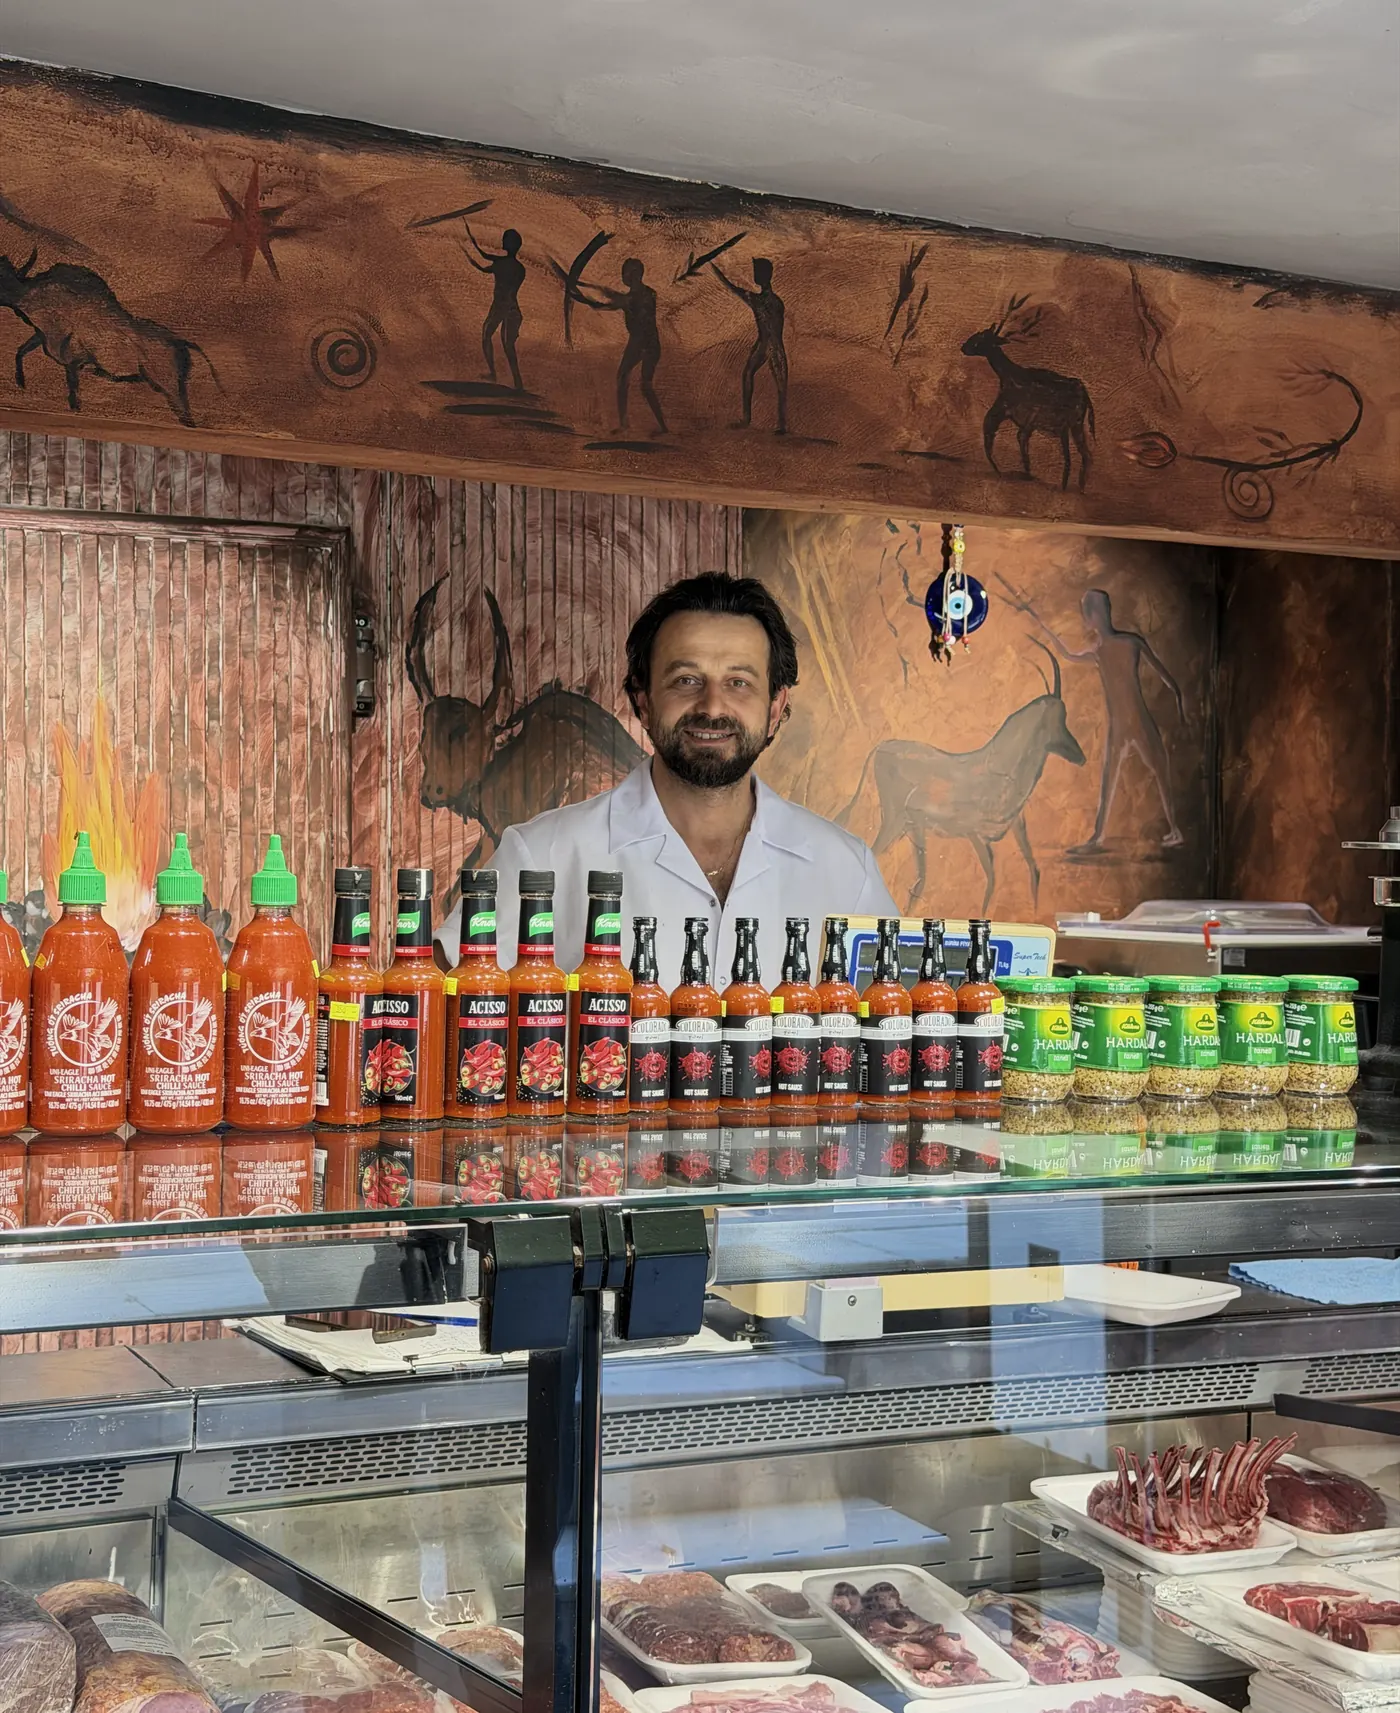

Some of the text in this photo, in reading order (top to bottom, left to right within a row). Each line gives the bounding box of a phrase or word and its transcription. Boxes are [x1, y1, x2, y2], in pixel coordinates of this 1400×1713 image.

[53, 991, 92, 1016] SRIRACHA
[149, 991, 187, 1015] SRIRACHA
[244, 991, 281, 1014] SRIRACHA
[468, 1000, 505, 1014] ACISSO
[527, 999, 563, 1012] ACISSO
[588, 998, 626, 1012] ACISSO
[1235, 1032, 1284, 1045] HARDAL
[8, 1075, 22, 1085] HOT
[54, 1074, 116, 1084] SRIRACHA HOT
[150, 1072, 210, 1082] SRIRACHA HOT
[245, 1071, 304, 1080] SRIRACHA HOT
[61, 1083, 112, 1091] CHILLI SAUCE
[156, 1080, 206, 1089] CHILLI SAUCE
[251, 1079, 300, 1088] CHILLI SAUCE
